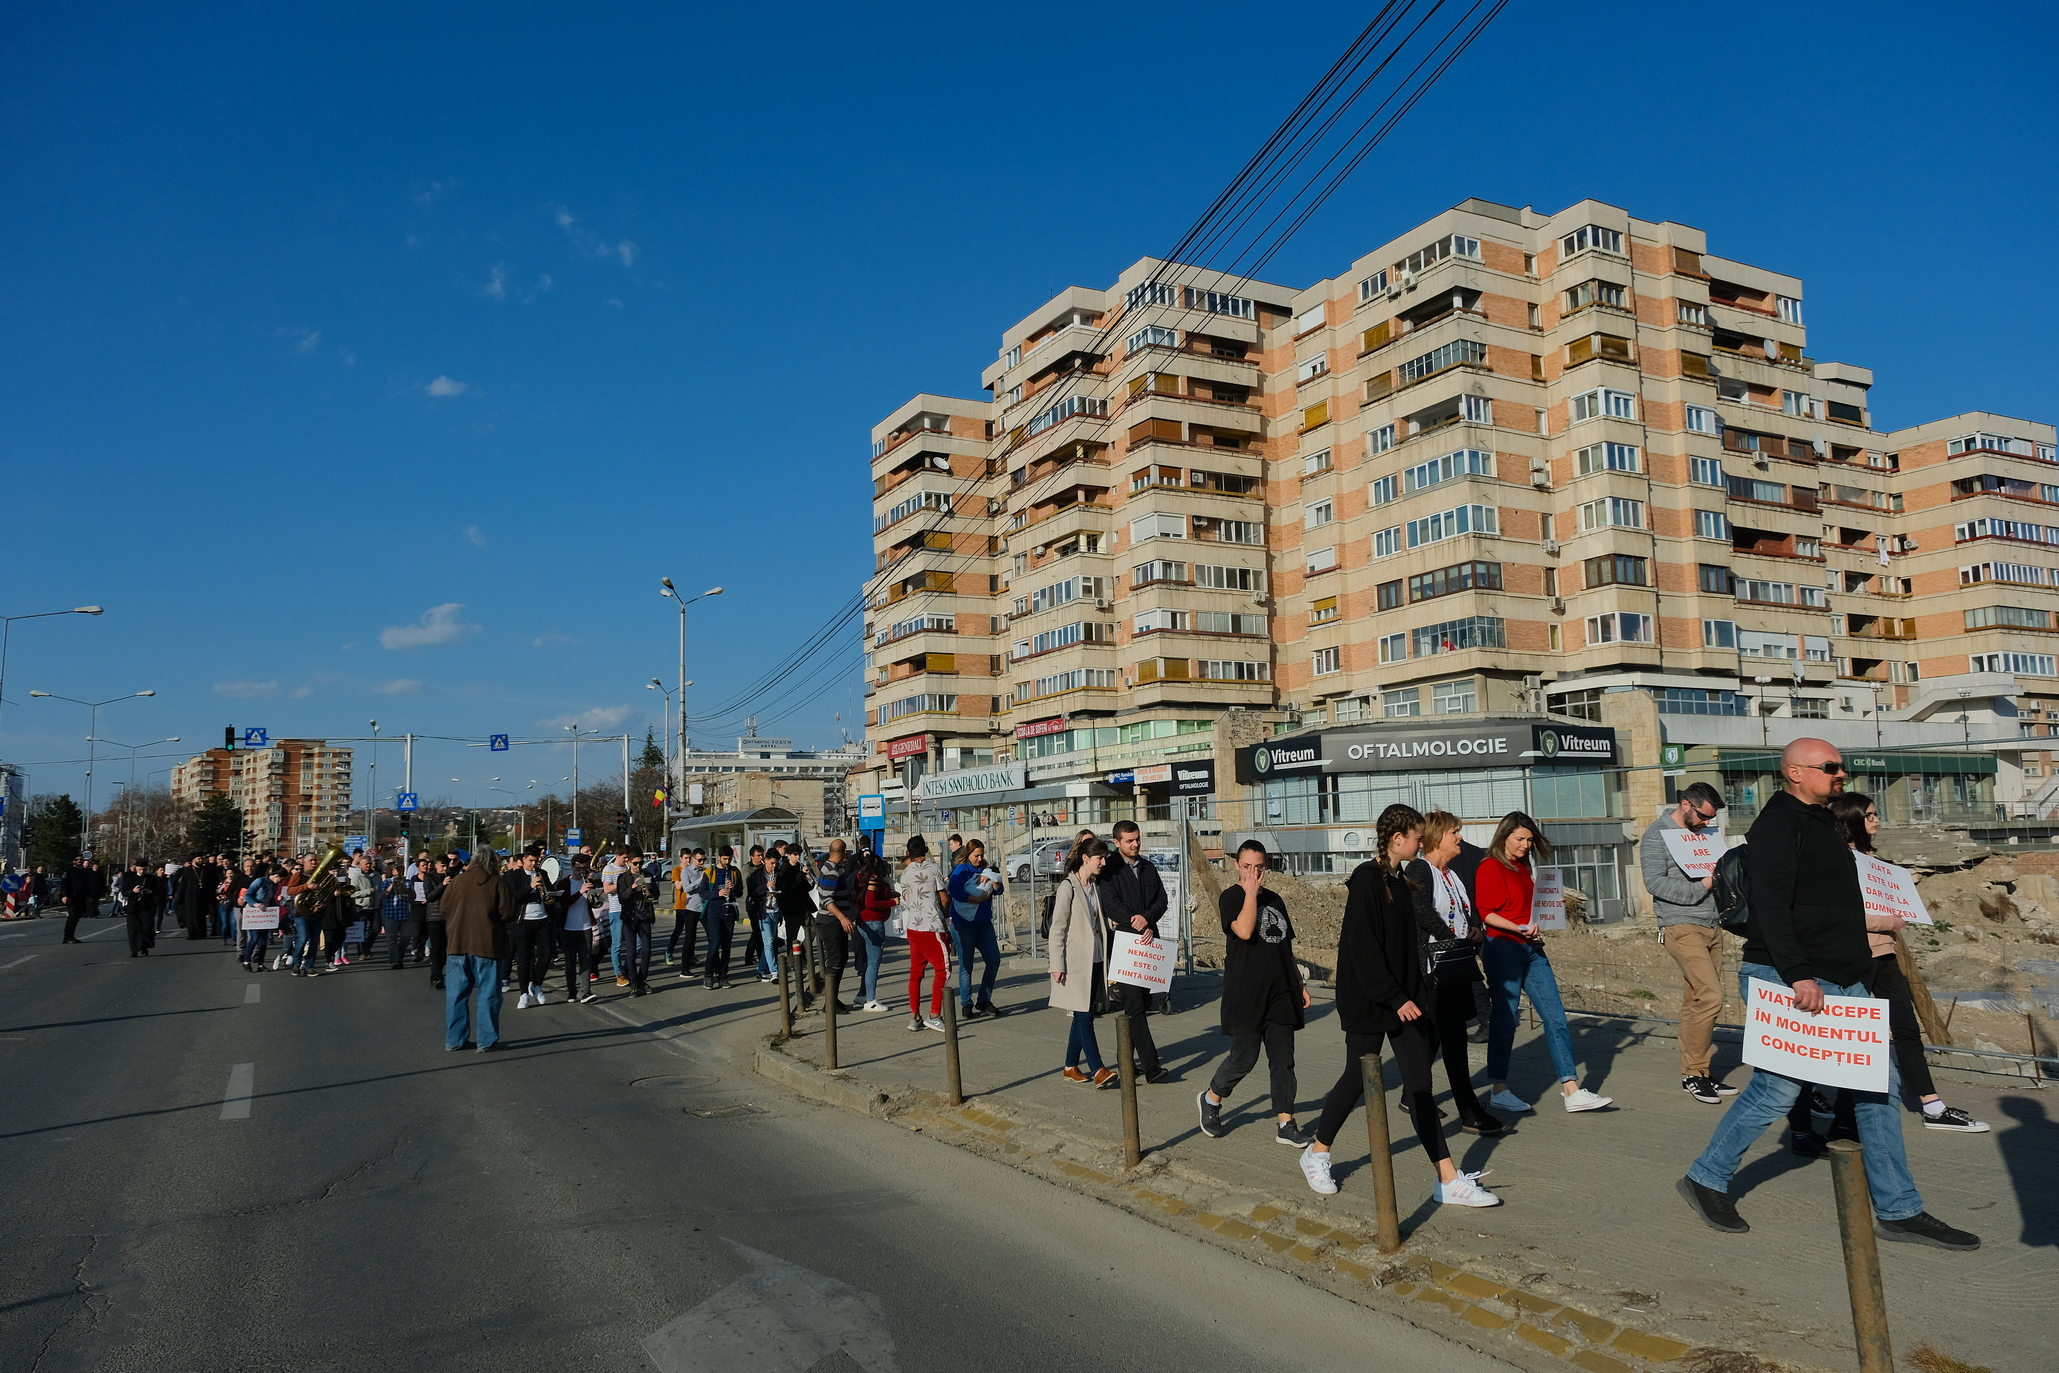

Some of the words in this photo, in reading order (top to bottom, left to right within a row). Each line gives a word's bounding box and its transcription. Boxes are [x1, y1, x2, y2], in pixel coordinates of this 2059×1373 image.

[898, 738, 922, 754] GENERALI
[1347, 737, 1508, 760] OFTALMOLOGIE
[1561, 734, 1610, 751] Vitreum
[1271, 748, 1314, 764] Vitreum
[1853, 758, 1865, 766] CEC
[922, 779, 947, 797] INTESA
[948, 773, 988, 794] SANPAOLO
[989, 770, 1015, 789] BANK
[1177, 769, 1209, 781] Vitreum
[1179, 781, 1209, 790] OFTALMOLOGIE
[1693, 848, 1711, 856] ARE
[1684, 862, 1717, 870] PRIORIT
[1866, 873, 1886, 886] ESTE
[1888, 882, 1900, 890] UN
[1866, 886, 1884, 898] DAR
[1884, 893, 1895, 902] DE
[1896, 896, 1910, 906] LA
[1865, 901, 1917, 918] DUMNEZEU
[1134, 960, 1151, 970] ESTE
[1758, 988, 1794, 1010] VIAȚ
[1817, 1004, 1881, 1020] NCEPE
[1755, 1008, 1771, 1024] ÎN
[1776, 1016, 1882, 1044] MOMENTUL
[1760, 1034, 1871, 1066] CONCEPȚIEI
